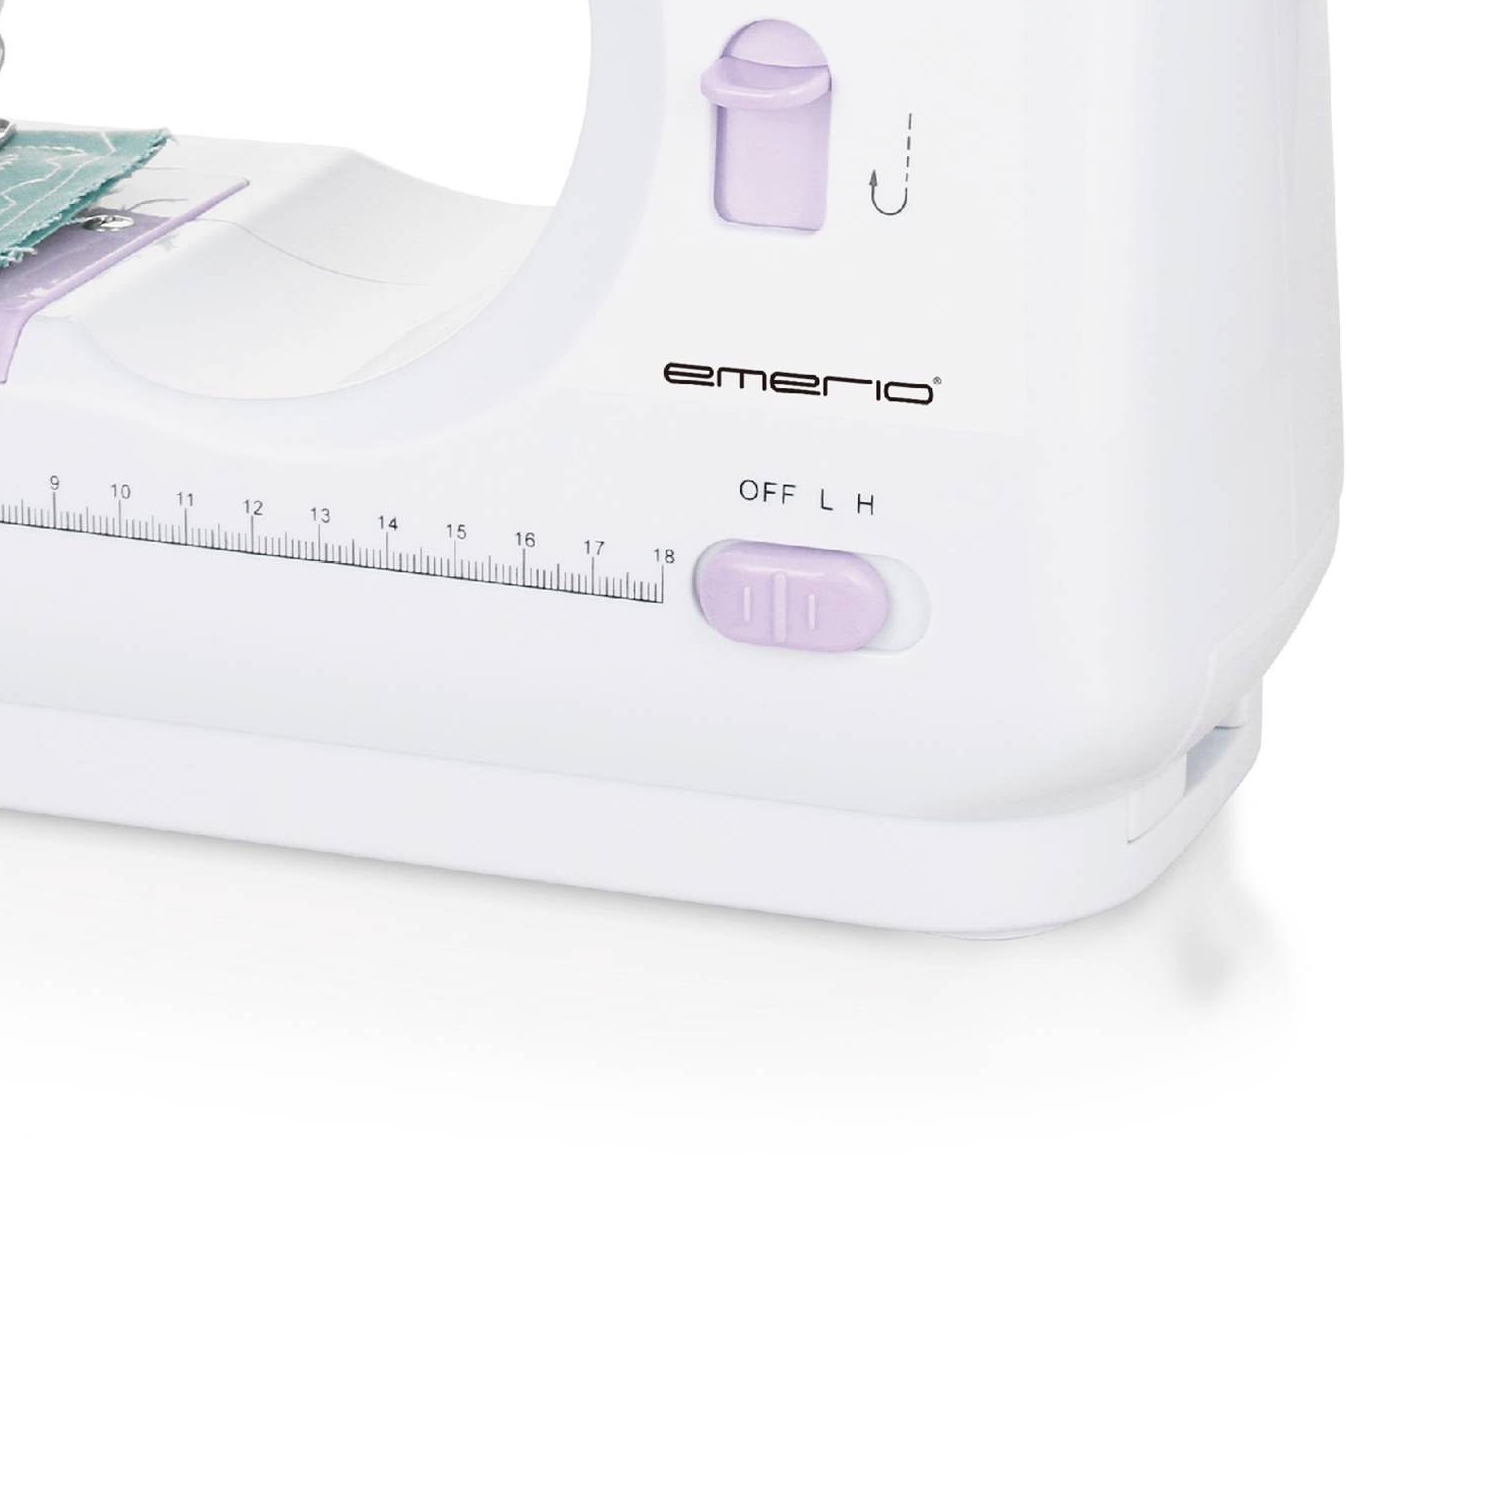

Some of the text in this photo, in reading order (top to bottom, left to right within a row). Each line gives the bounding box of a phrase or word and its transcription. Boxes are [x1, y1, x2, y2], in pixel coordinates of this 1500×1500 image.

[48, 475, 61, 492] 9
[110, 483, 131, 500] 10
[176, 491, 196, 507] 11
[242, 500, 264, 516] 12
[309, 507, 331, 524] 13
[376, 515, 399, 532] 14
[445, 523, 468, 541] 15
[514, 531, 536, 549] 16
[583, 539, 604, 557] 17
[653, 548, 675, 565] 18
[739, 479, 873, 515] OFF L H
